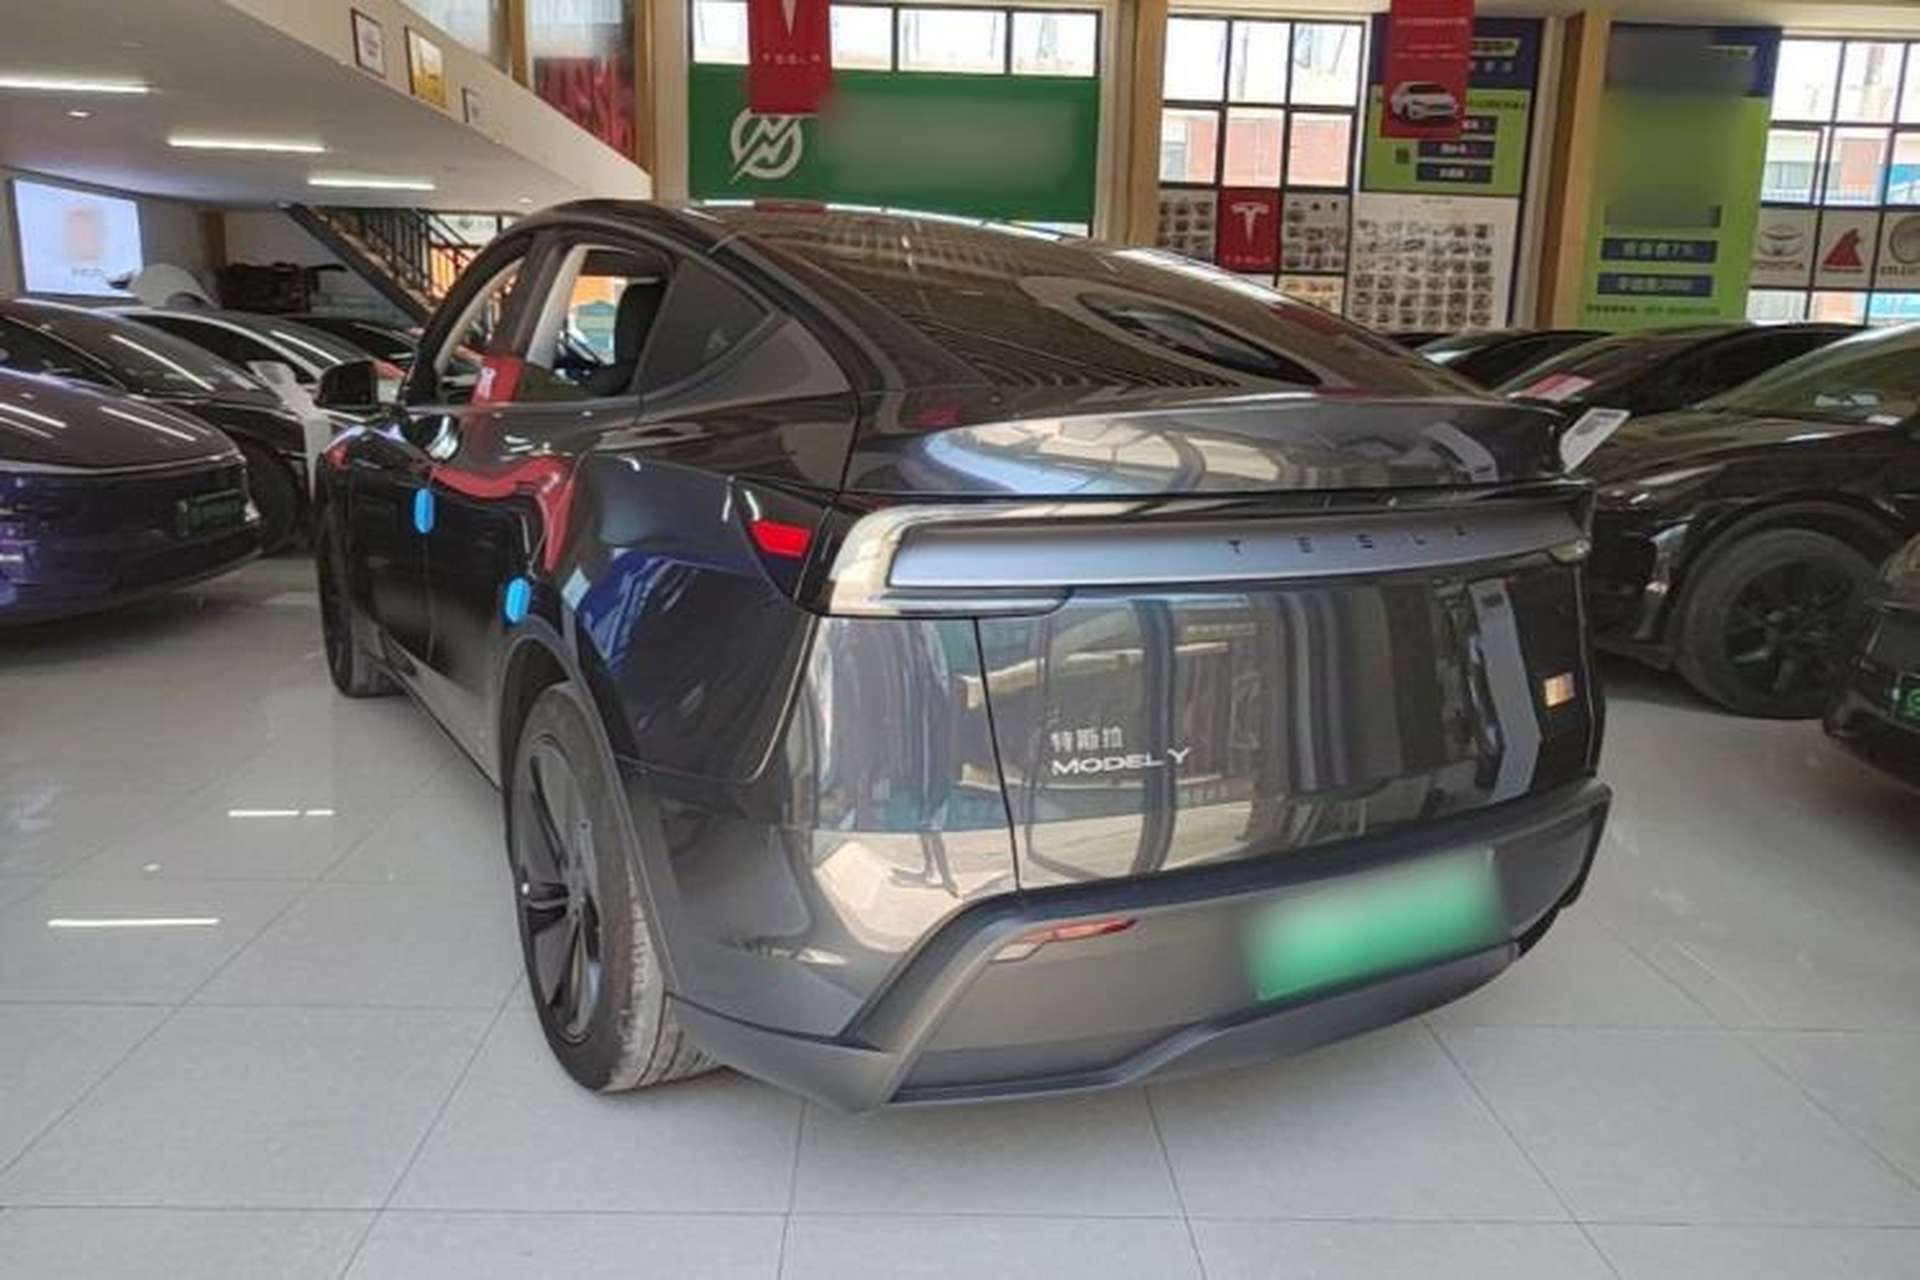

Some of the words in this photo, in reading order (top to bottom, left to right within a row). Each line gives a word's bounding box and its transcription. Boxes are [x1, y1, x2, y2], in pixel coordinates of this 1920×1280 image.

[1050, 726, 1124, 753] 特斯拉
[1051, 751, 1165, 777] MODEL
[1166, 746, 1192, 765] Y
